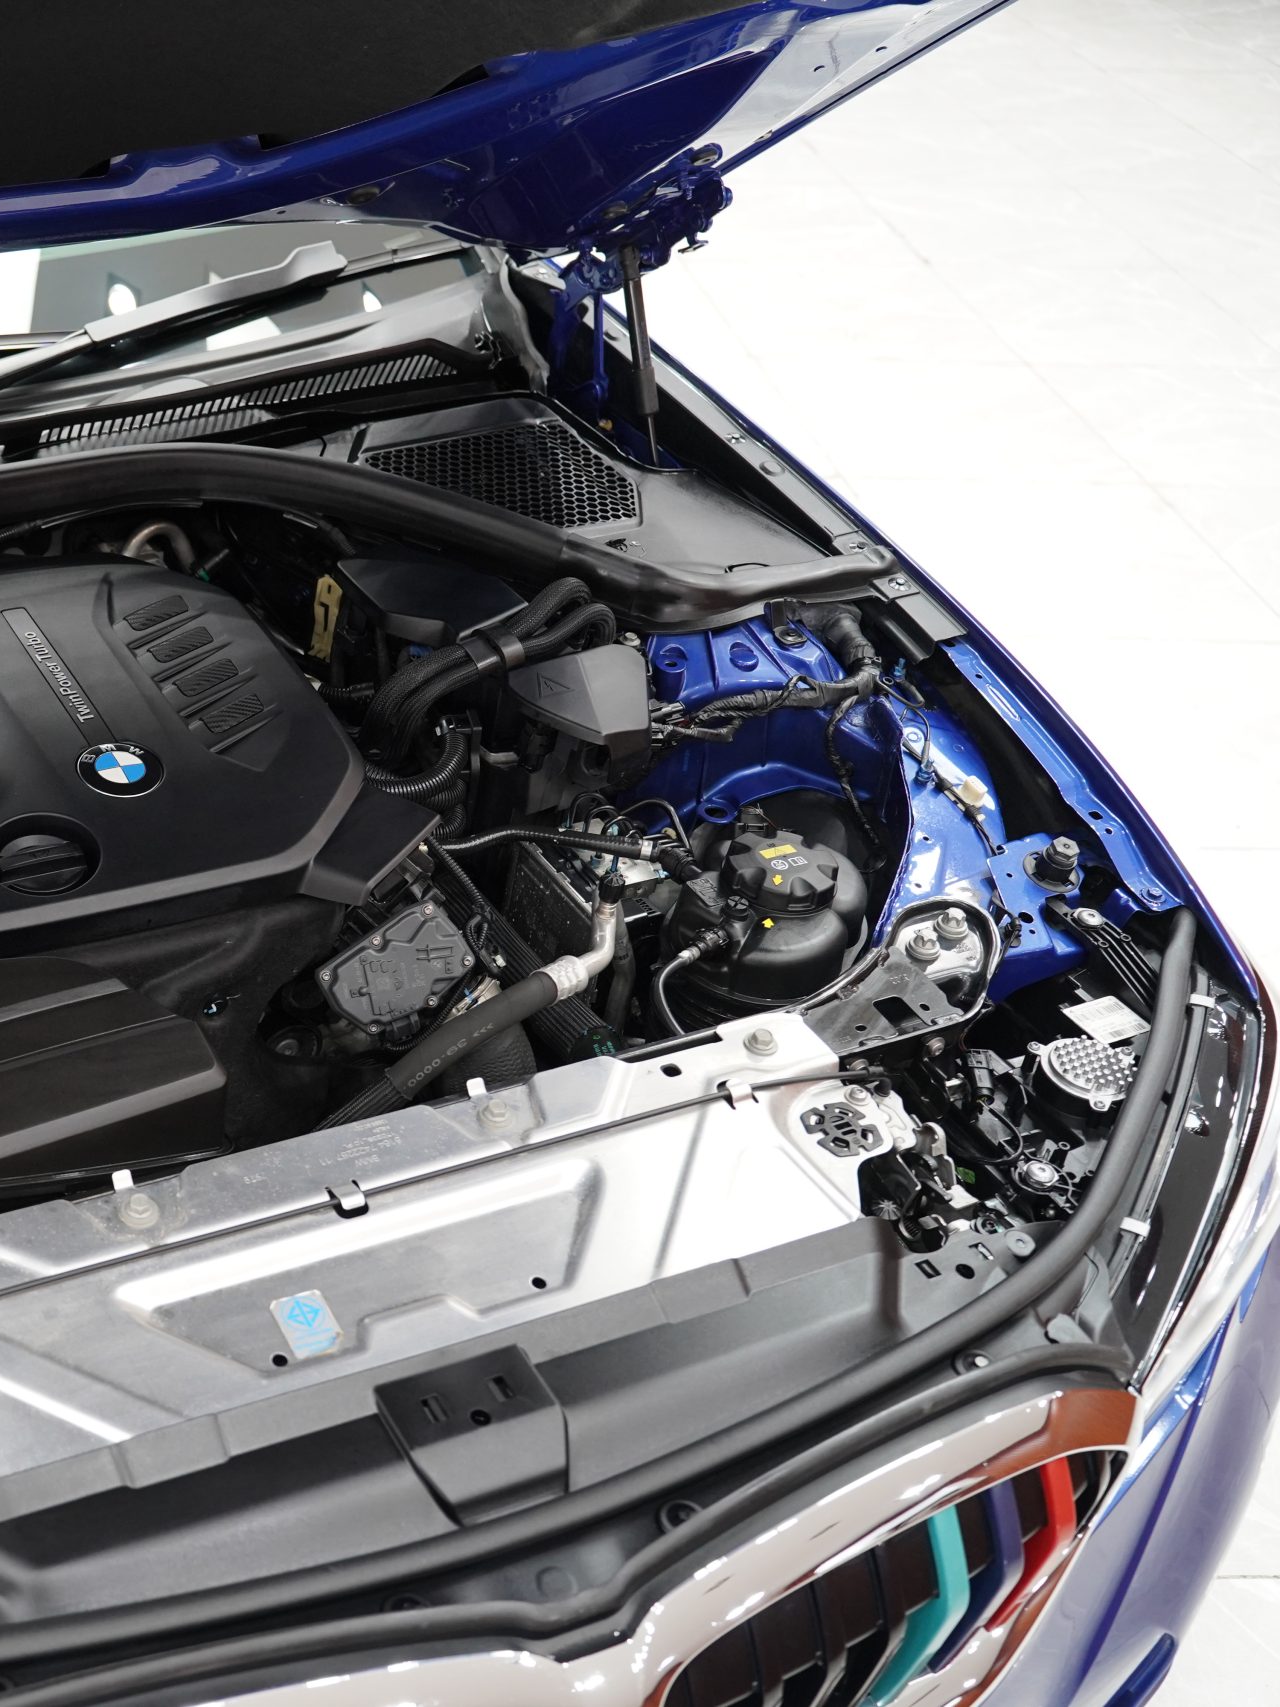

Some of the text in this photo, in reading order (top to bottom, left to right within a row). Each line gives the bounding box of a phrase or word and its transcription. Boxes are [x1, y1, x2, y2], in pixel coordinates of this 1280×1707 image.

[24, 631, 94, 722] TwinPower Turbo
[81, 743, 144, 763] BMW
